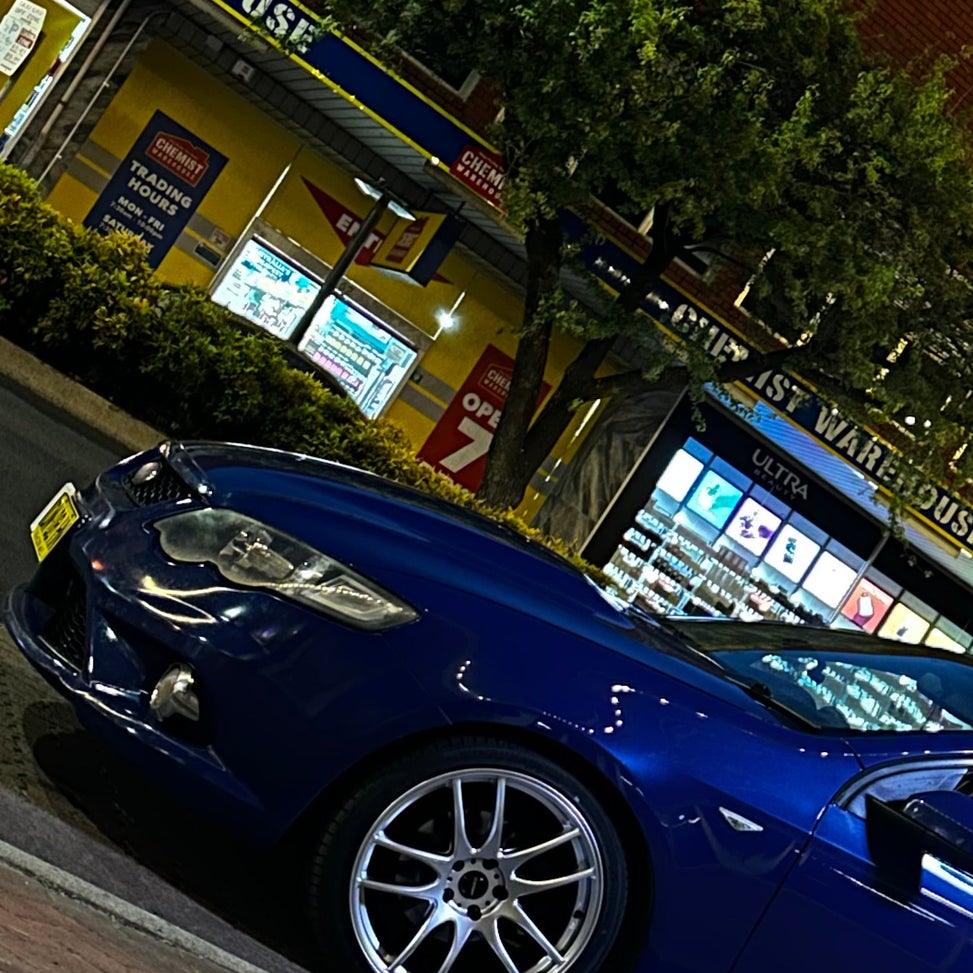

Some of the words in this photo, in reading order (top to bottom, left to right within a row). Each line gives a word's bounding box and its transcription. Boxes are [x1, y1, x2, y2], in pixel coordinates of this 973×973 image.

[155, 137, 204, 175] CHEMIST
[127, 177, 179, 217] HOURS
[130, 160, 192, 209] TRADING
[117, 196, 144, 218] MON
[148, 214, 165, 231] FRI
[438, 416, 494, 474] 7
[752, 448, 808, 500] ULTRA
